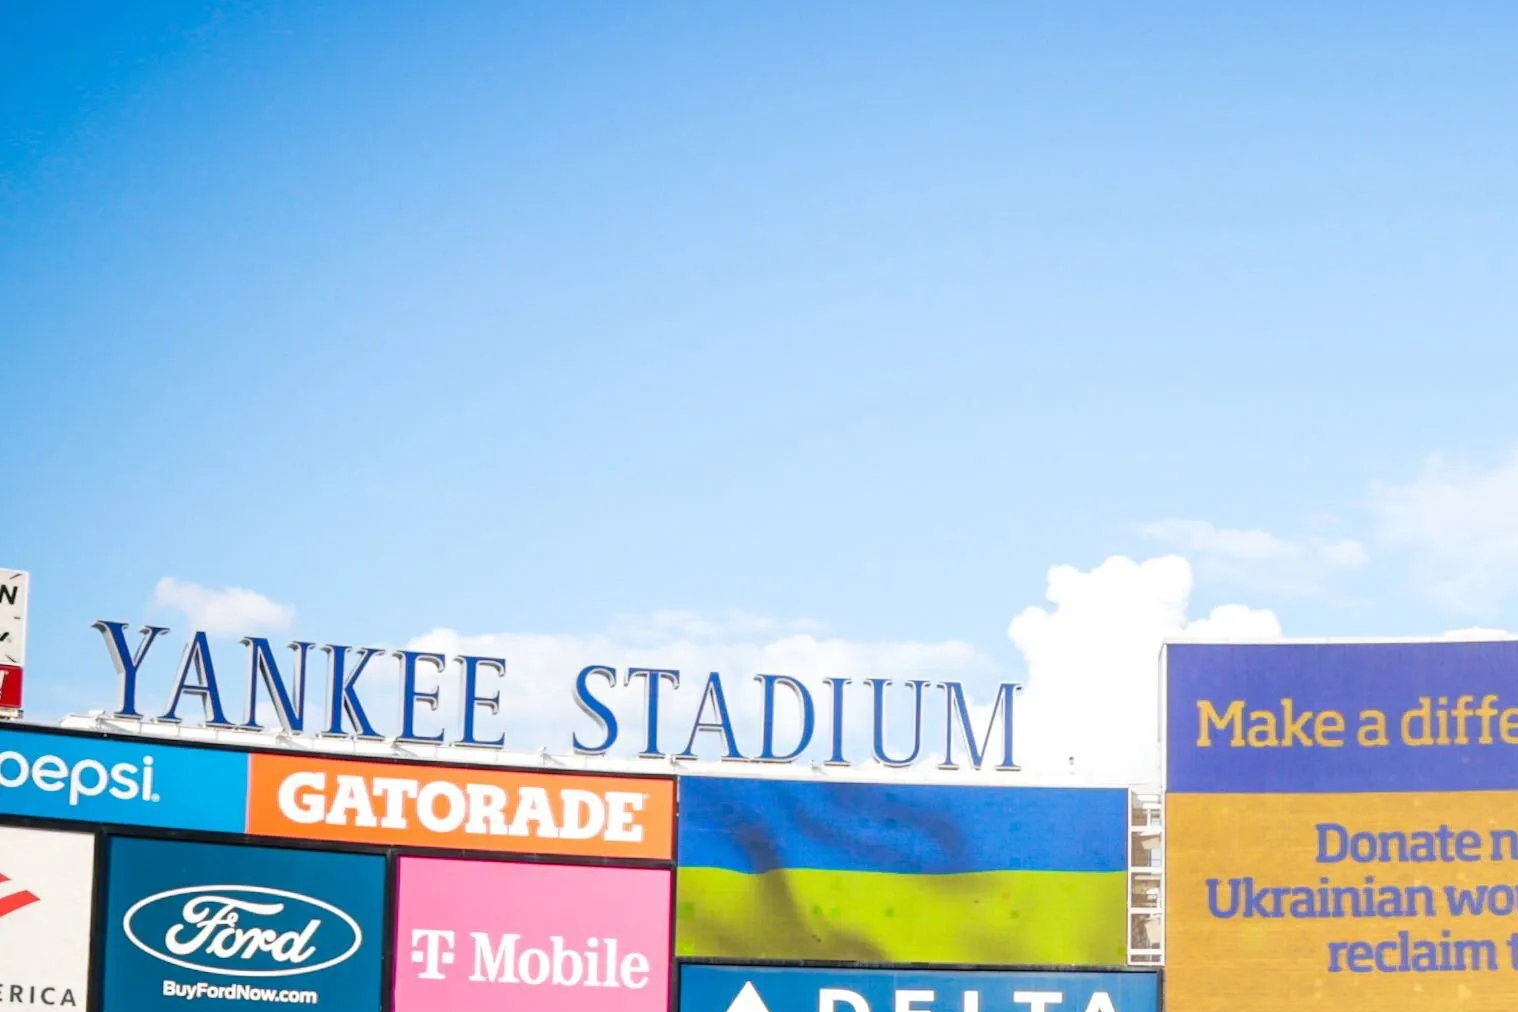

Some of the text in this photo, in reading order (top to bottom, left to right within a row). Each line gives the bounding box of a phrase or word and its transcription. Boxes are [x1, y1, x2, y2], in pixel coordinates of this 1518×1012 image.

[91, 620, 1023, 771] YANKEE STADIUM
[1197, 698, 1345, 748] Make
[1356, 710, 1389, 746] a
[278, 771, 648, 842] GATORADE
[1315, 822, 1480, 864] Donate
[1206, 877, 1434, 919] Ukrainian
[165, 895, 321, 961] Ford
[469, 931, 649, 989] Mobile
[1328, 932, 1498, 974] reclaim
[0, 983, 76, 1007] RICA
[163, 981, 317, 1005] BuyFordNow.com
